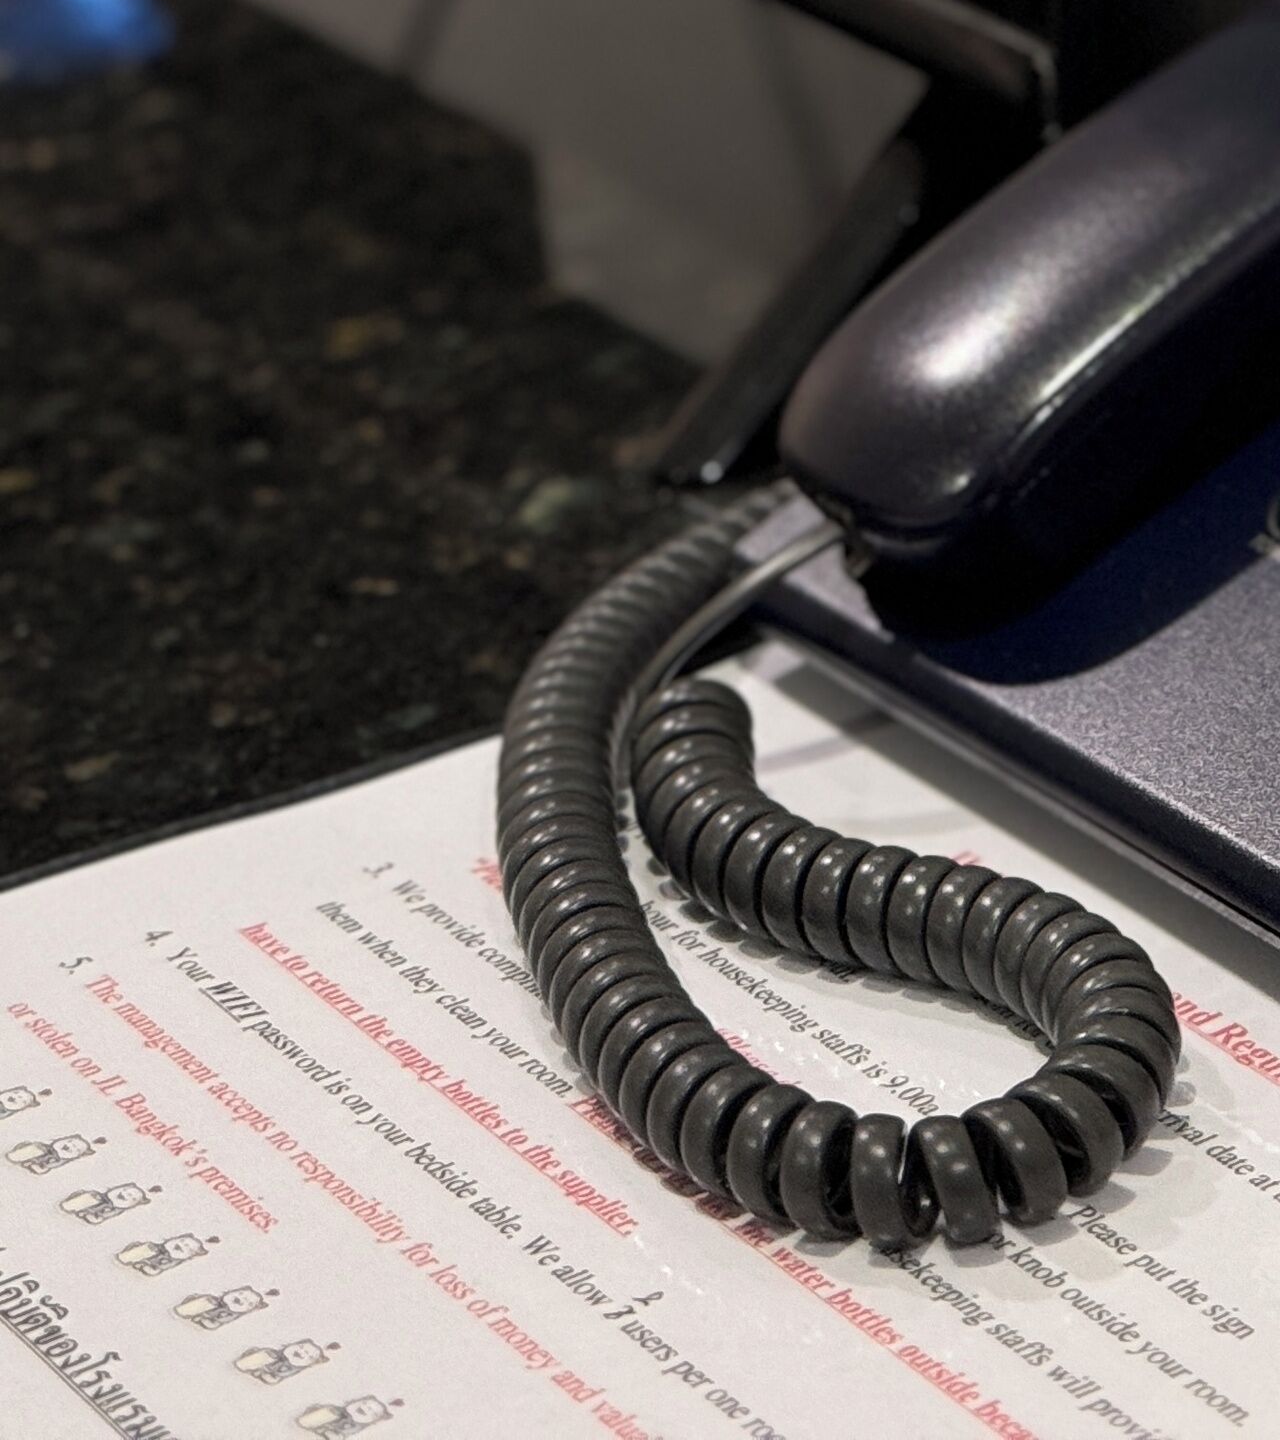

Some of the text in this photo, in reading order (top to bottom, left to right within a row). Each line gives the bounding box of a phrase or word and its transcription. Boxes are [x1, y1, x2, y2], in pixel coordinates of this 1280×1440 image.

[144, 930, 174, 948] 4.
[165, 946, 216, 983] Your
[197, 980, 270, 1024] WIFI
[240, 1019, 343, 1083] password
[238, 921, 640, 1234] have to return the empty bottles to the supplier.
[321, 1077, 353, 1096] is
[6, 1002, 38, 1020] or
[23, 1017, 81, 1060] stolen
[69, 1057, 103, 1079] on
[89, 1074, 129, 1098] JL
[189, 1165, 277, 1235] premises.
[339, 1093, 374, 1117] on
[356, 1112, 416, 1147] your
[391, 879, 426, 904] We
[409, 903, 486, 949] provide
[983, 1323, 1055, 1367] staffs
[1046, 1364, 1103, 1400] will
[671, 929, 707, 952] for
[695, 946, 821, 1034] housekeeping
[809, 1028, 872, 1067] staffs
[859, 1060, 890, 1080] is
[1066, 1208, 1139, 1256] Please
[1120, 1253, 1178, 1283] put
[1165, 1277, 1210, 1306] the
[1199, 1304, 1255, 1341] sign
[315, 901, 364, 934] them
[356, 931, 408, 969] when
[398, 965, 446, 995] they
[434, 994, 489, 1031] clean
[470, 1027, 530, 1060] your
[518, 1060, 573, 1099] room.
[770, 1244, 836, 1291] water
[825, 1287, 905, 1346] bottles
[897, 1344, 981, 1403] outside
[403, 1141, 479, 1200] bedside
[1204, 1144, 1256, 1176] date
[57, 956, 607, 1404] 5. The management accepts no responsibility for loss of money and
[467, 1196, 523, 1241] table.
[521, 1234, 562, 1267] We
[549, 1264, 615, 1307] allow
[618, 1319, 680, 1363] users
[1007, 1246, 1250, 1428] knob outside your room.
[665, 1360, 715, 1389] per
[704, 1388, 751, 1420] one
